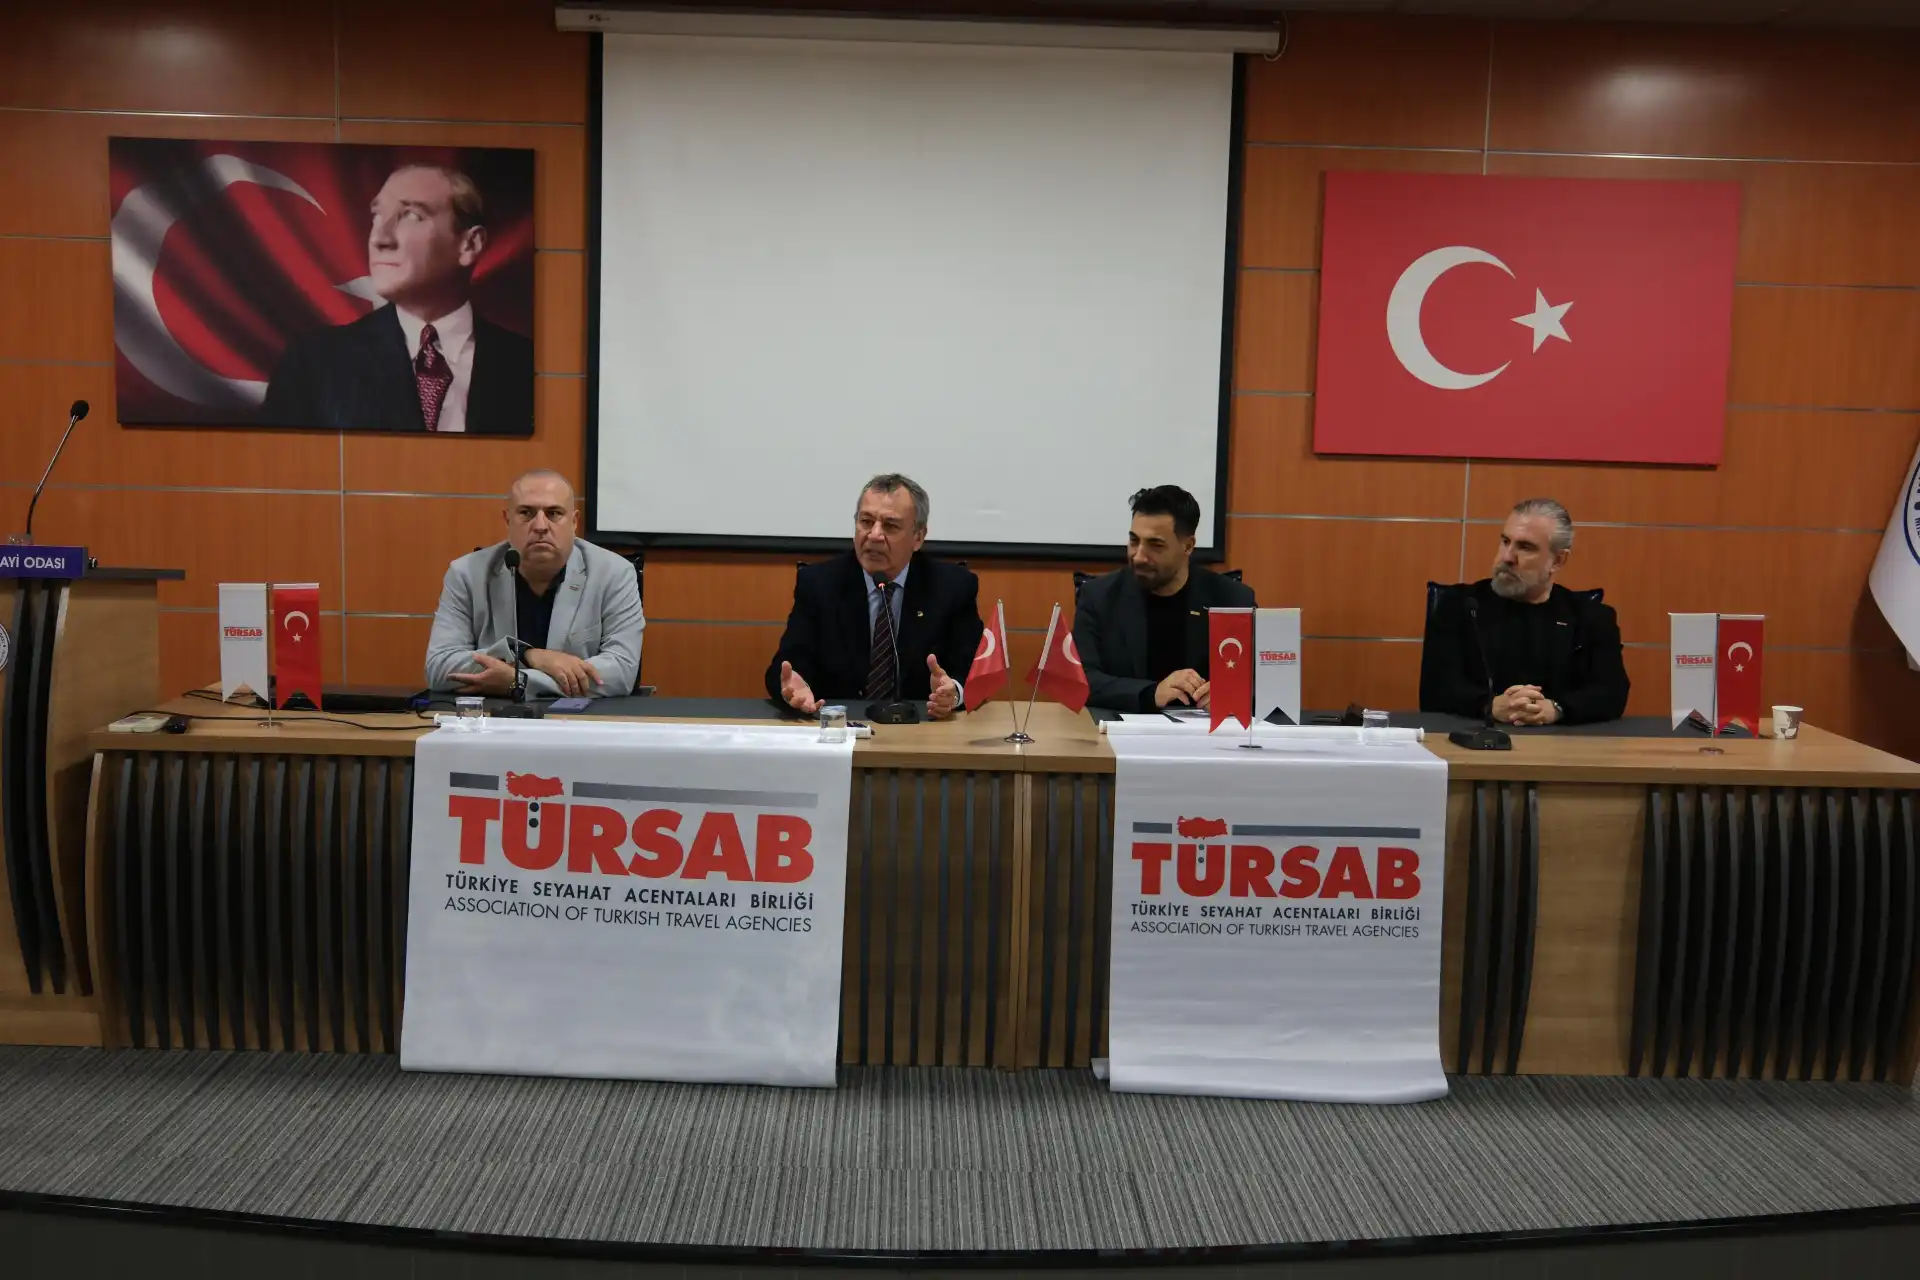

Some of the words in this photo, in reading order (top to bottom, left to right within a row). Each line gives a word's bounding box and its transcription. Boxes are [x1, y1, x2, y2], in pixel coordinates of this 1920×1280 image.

[24, 556, 65, 569] ODASI
[448, 794, 815, 884] TÜRSAB
[1131, 842, 1421, 899] TÜRSAB
[445, 870, 518, 894] TÜRKİYE
[533, 881, 611, 901] SEYAHAT
[625, 888, 736, 908] ACENTALARI
[750, 891, 814, 910] BİRLİĞİ
[444, 896, 559, 919] ASSOCIATION
[565, 906, 588, 921] OF
[594, 908, 659, 926] TURKISH
[666, 912, 720, 929] TRAVEL
[725, 915, 812, 932] AGENCIES
[1131, 900, 1189, 917] TÜRKİYE
[1200, 906, 1262, 918] SEYAHAT
[1273, 907, 1360, 920] ACENTALARI
[1371, 906, 1420, 921] BİRLİĞİ
[1131, 921, 1222, 935] ASSOCIATION
[1226, 923, 1244, 935] OF
[1249, 923, 1300, 936] TURKISH
[1305, 924, 1348, 937] TRAVEL
[1352, 925, 1419, 938] AGENCIES
